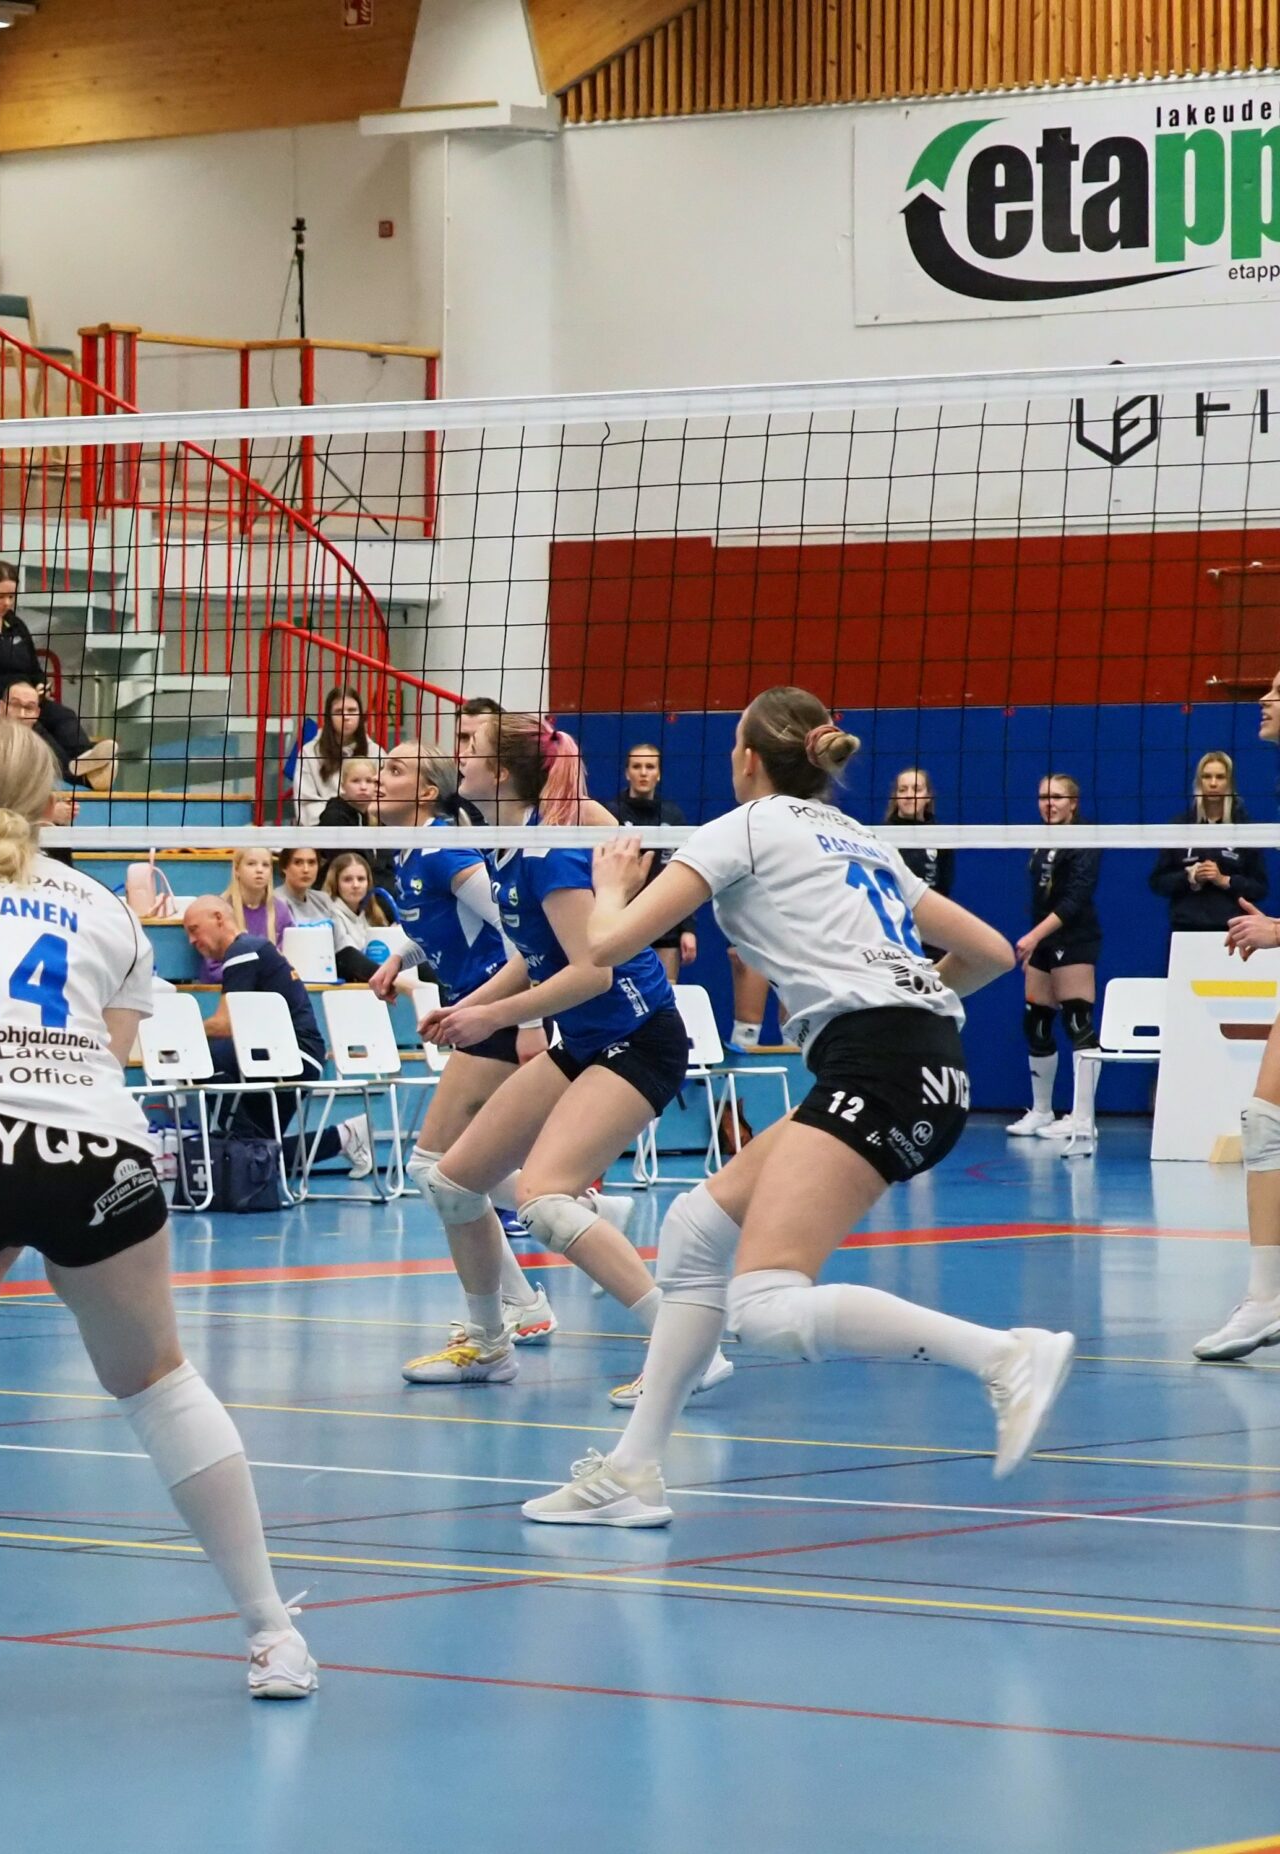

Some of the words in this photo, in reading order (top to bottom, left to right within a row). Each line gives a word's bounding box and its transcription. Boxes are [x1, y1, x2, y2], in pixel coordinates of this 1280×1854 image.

[1156, 99, 1280, 128] lakeude
[1228, 264, 1280, 283] etapp
[9, 1066, 94, 1087] Office
[828, 1090, 865, 1123] 12
